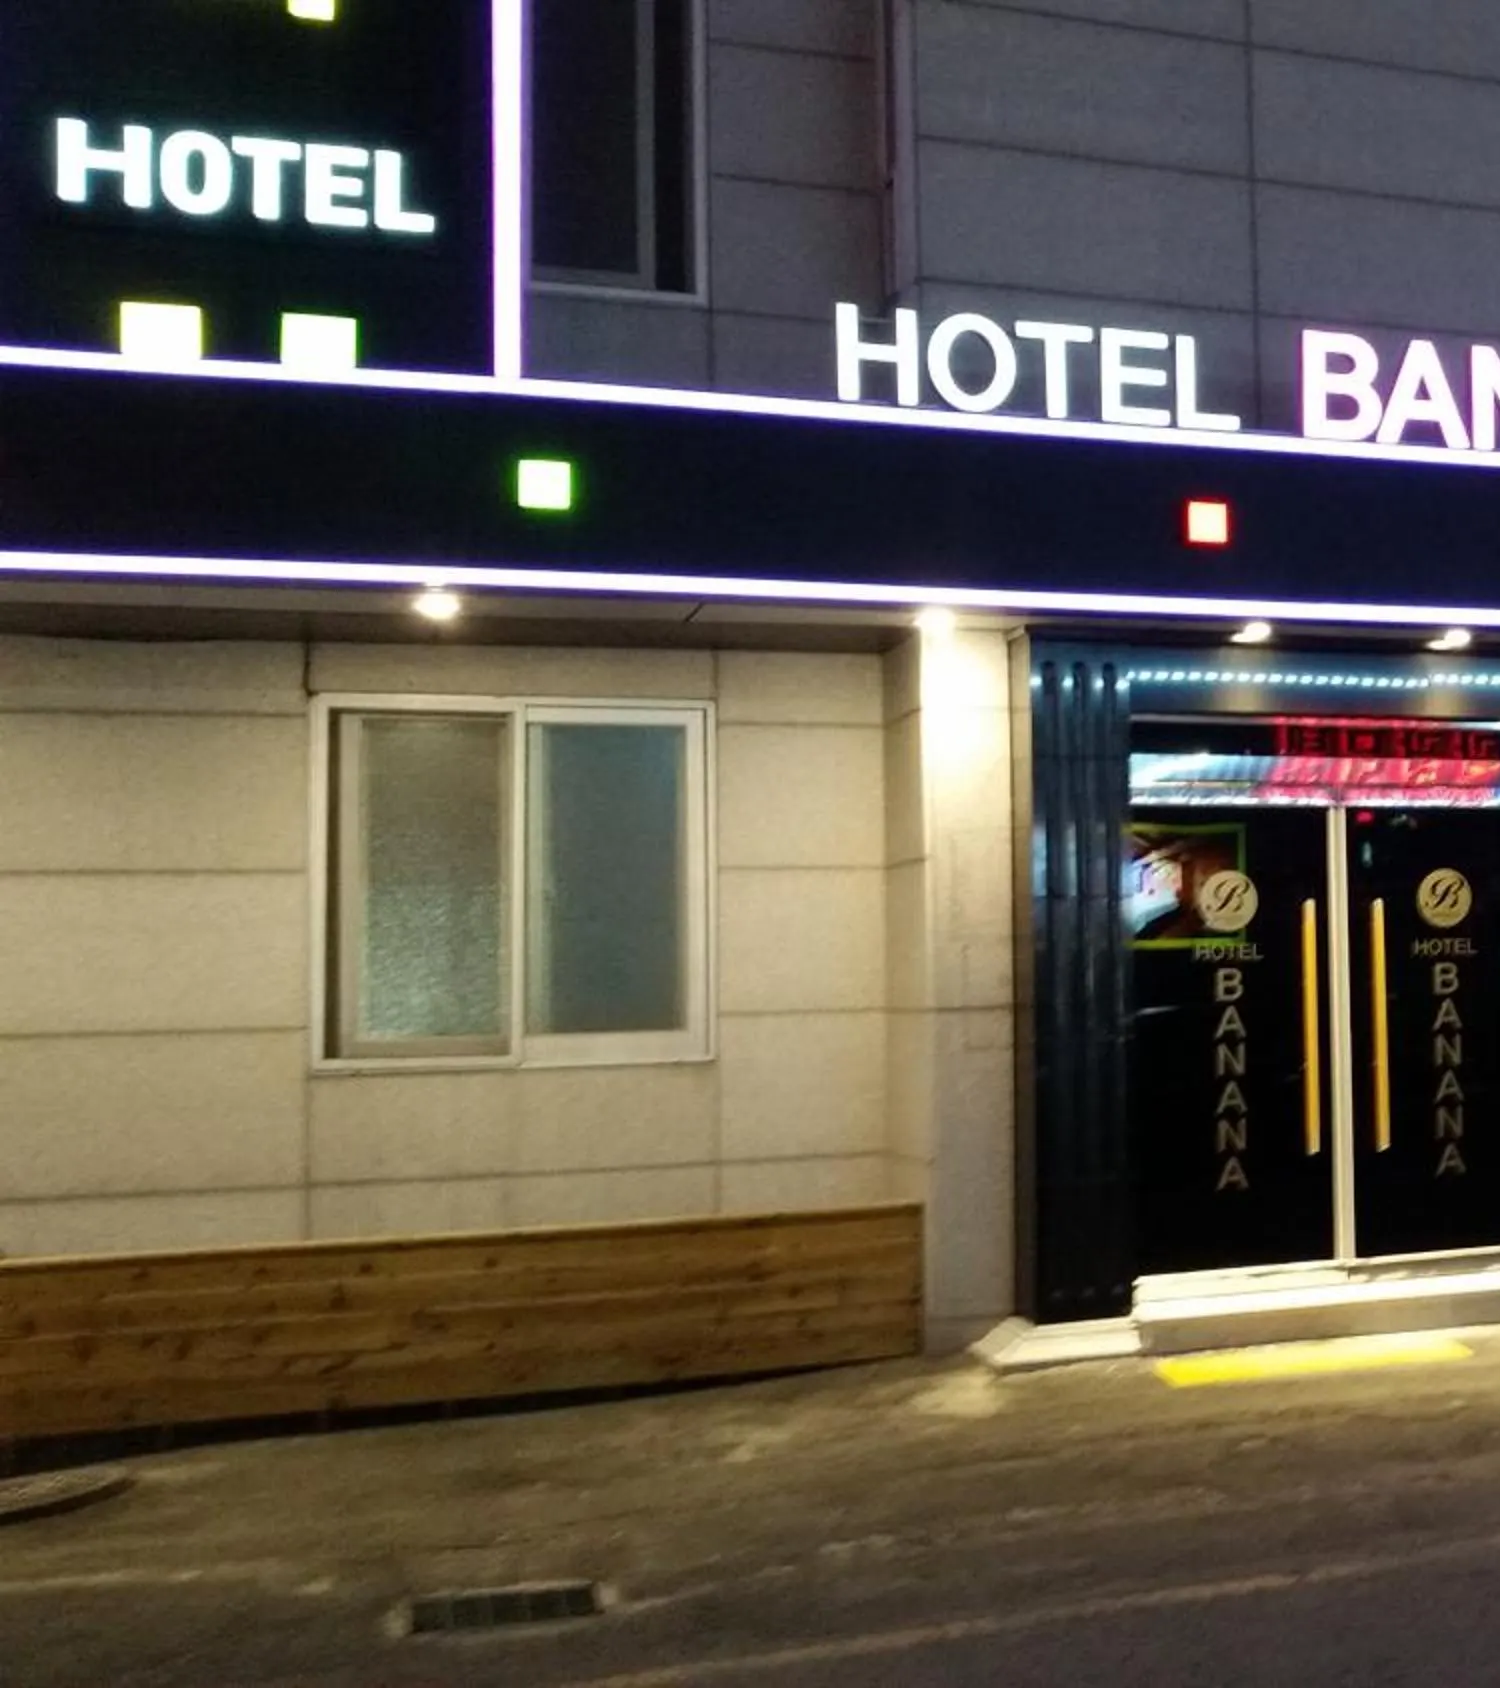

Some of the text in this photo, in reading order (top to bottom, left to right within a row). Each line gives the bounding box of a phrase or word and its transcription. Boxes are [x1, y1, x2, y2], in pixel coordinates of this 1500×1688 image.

[55, 116, 436, 234] HOTEL
[834, 302, 1241, 432] HOTEL
[1193, 943, 1265, 962] HOTEL
[1411, 937, 1478, 958] HOTEL
[1213, 967, 1250, 1192] BANANA
[1431, 962, 1467, 1180] BANANA
